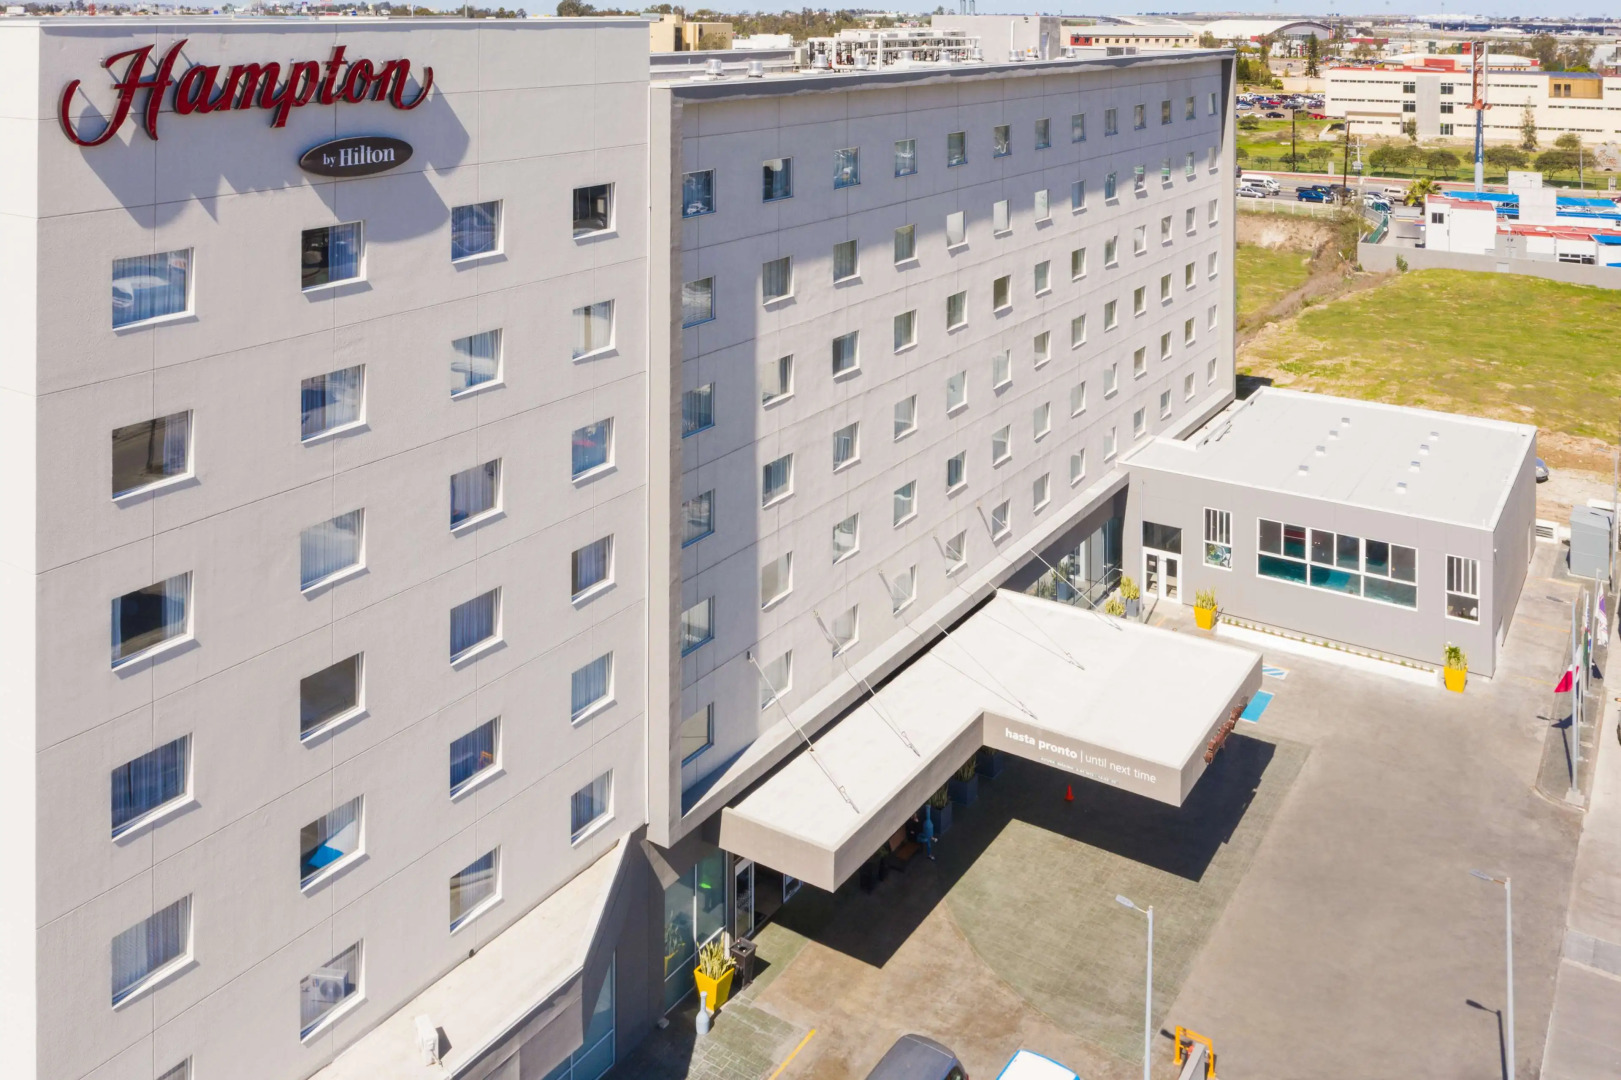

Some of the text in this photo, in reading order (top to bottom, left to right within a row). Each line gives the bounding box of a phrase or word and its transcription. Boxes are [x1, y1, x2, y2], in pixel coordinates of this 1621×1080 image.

[58, 38, 434, 147] Hampton
[322, 144, 395, 168] by Hilton
[1005, 727, 1036, 746] hasta
[1038, 740, 1078, 759] pronto
[1085, 754, 1107, 768] until
[1109, 762, 1131, 776] next
[1133, 768, 1157, 784] time
